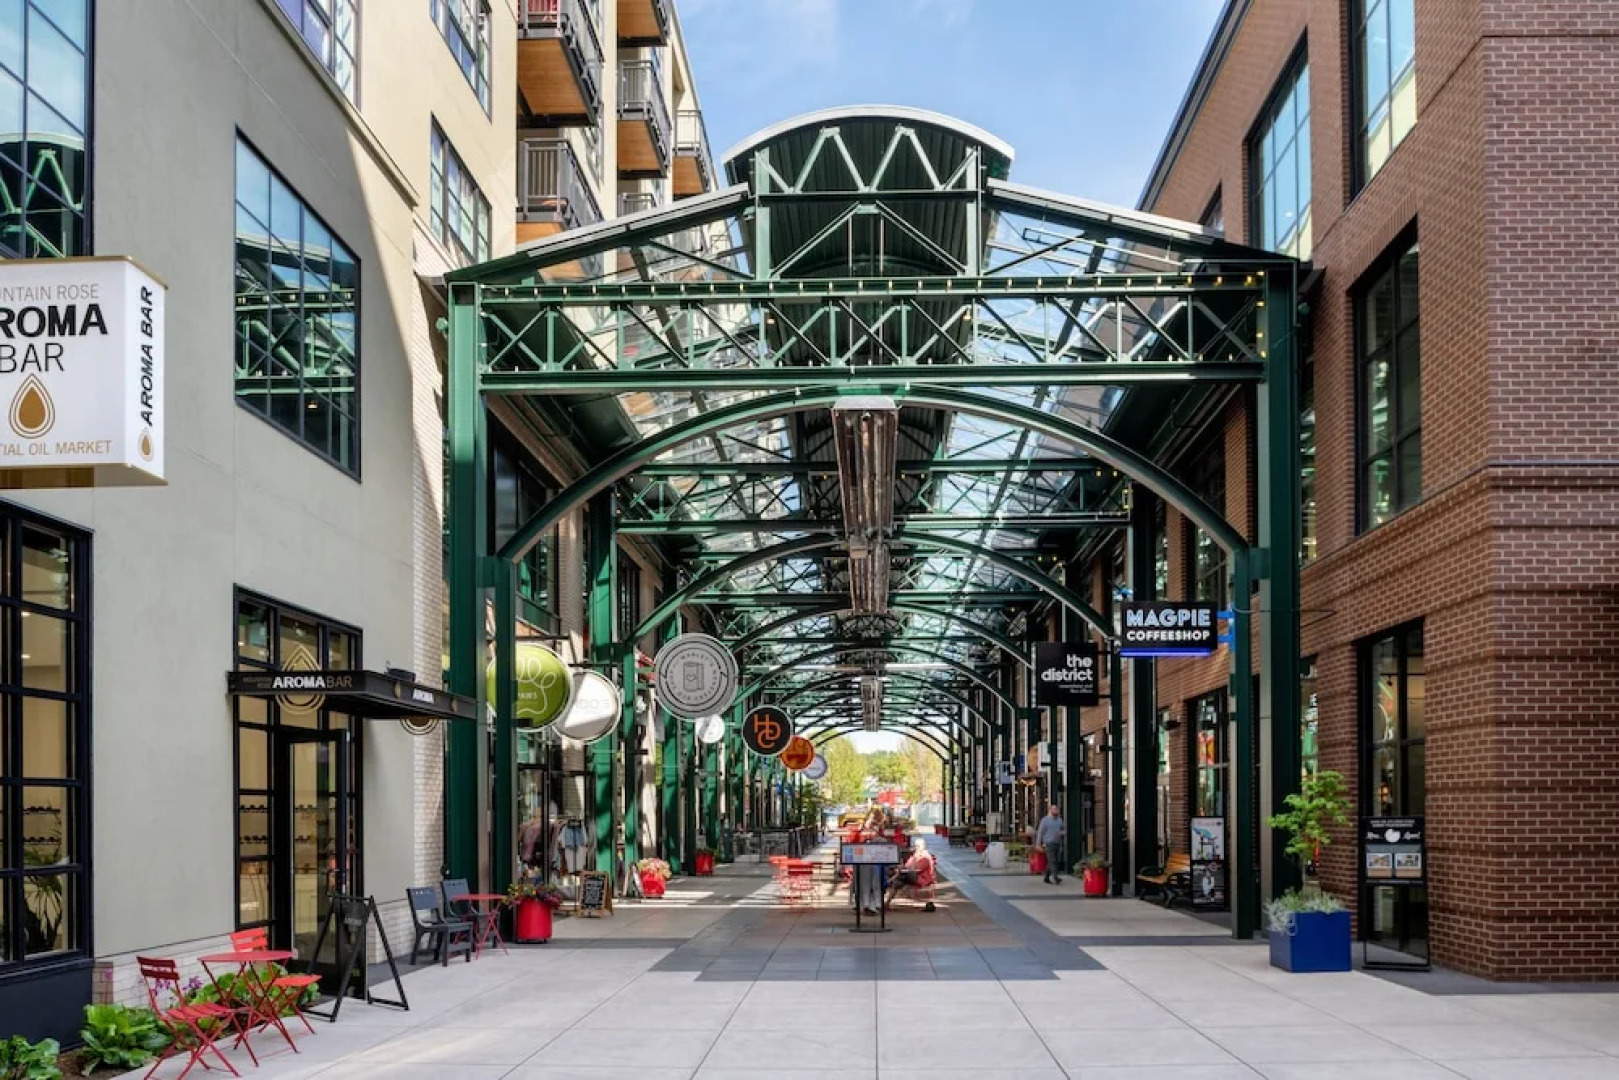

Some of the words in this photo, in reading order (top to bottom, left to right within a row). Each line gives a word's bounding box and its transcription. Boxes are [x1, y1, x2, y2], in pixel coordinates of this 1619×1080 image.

[0, 286, 51, 301] NTAIN
[57, 283, 100, 300] ROSE
[140, 285, 153, 339] BAR
[0, 342, 65, 373] BAR
[140, 344, 153, 427] AROMA
[28, 442, 50, 456] OIL
[55, 439, 112, 455] MARKET
[1126, 608, 1212, 628] MAGPIE
[1126, 630, 1211, 642] COFFEESHOP
[1066, 653, 1093, 668] the
[1041, 667, 1094, 682] district
